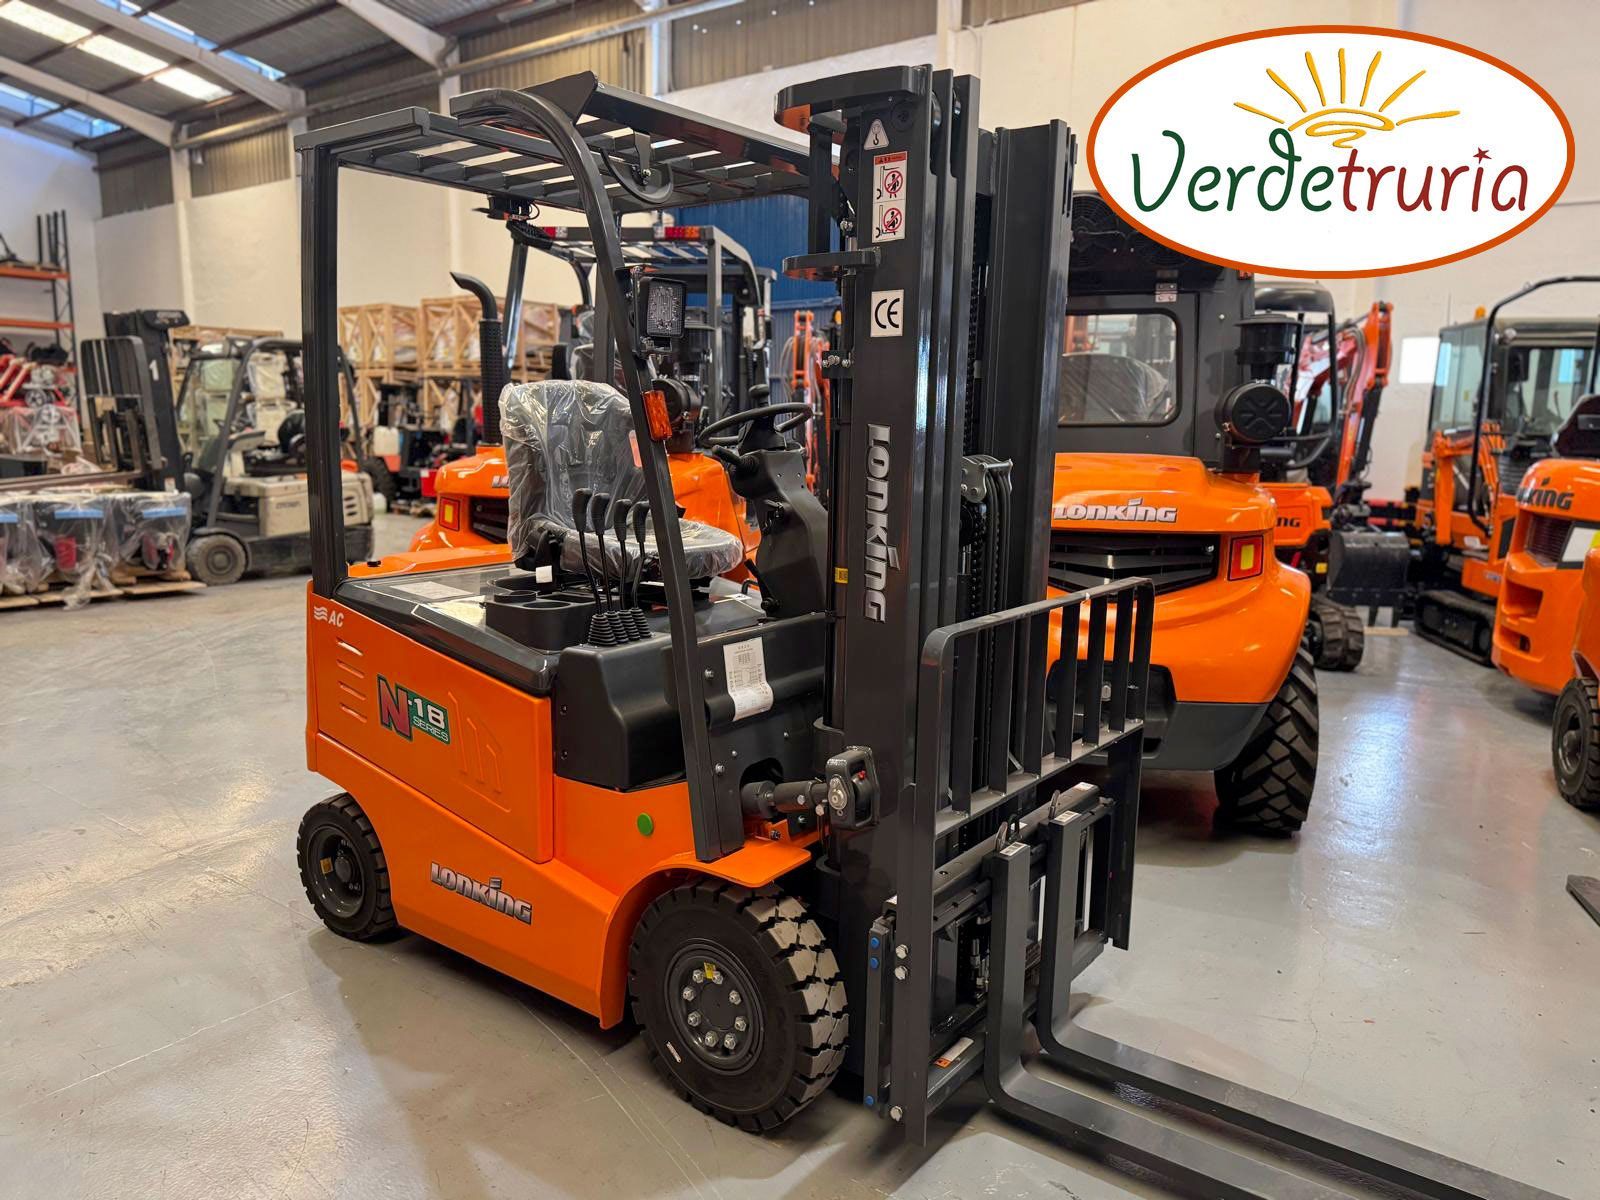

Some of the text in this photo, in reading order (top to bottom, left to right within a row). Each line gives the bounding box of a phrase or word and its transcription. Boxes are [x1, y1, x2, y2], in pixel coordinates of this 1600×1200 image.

[874, 297, 901, 329] CE
[328, 609, 345, 628] AC
[412, 714, 449, 742] SERIES
[430, 860, 533, 926] LONKING
